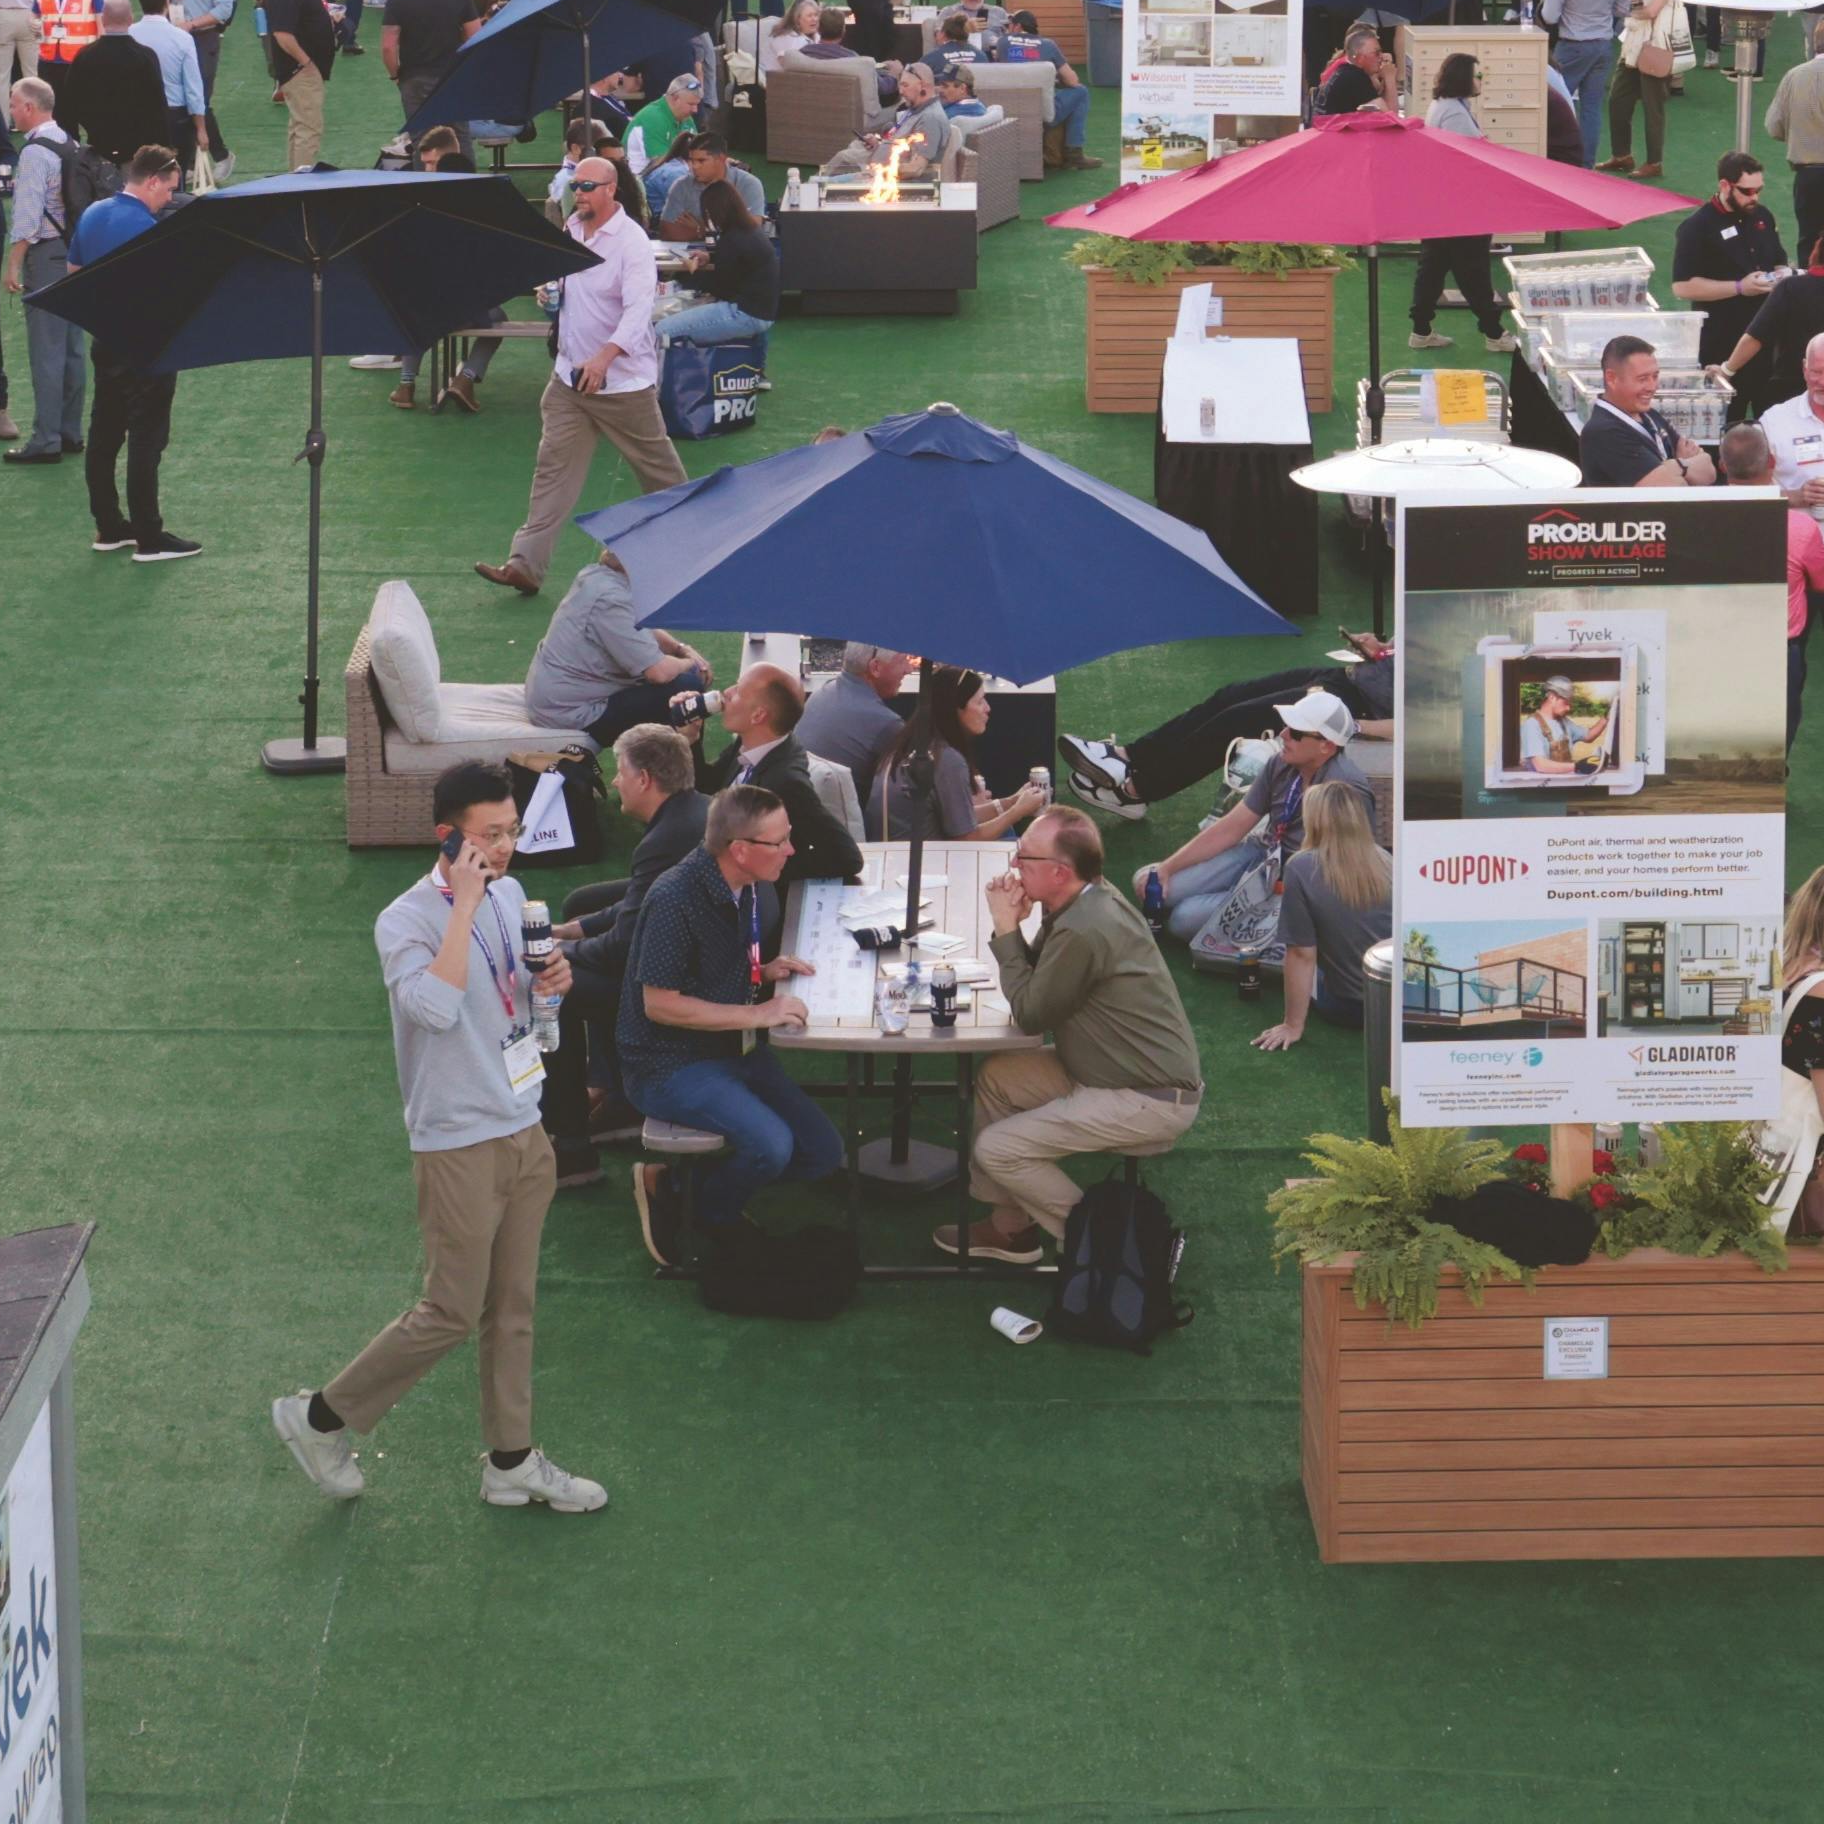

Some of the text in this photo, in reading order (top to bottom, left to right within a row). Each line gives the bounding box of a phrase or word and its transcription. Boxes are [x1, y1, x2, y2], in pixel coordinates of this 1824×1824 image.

[714, 394, 757, 424] PRO
[1527, 521, 1667, 544] PROBUILDER
[1527, 543, 1667, 560] SHOW VILLAGE
[1607, 567, 1637, 575] ACTION
[1567, 627, 1613, 646] Tyvek
[1547, 835, 1744, 847] DuPont air, thermal and weatherization
[1547, 848, 1763, 863] products work together to make your job
[1433, 854, 1518, 885] DUPONT
[1547, 863, 1751, 877] easier, and your homes perform better.
[1547, 887, 1724, 900] Dupont.com/building.html
[1450, 1050, 1514, 1066] feeney
[1648, 1045, 1737, 1062] GLADIATOR
